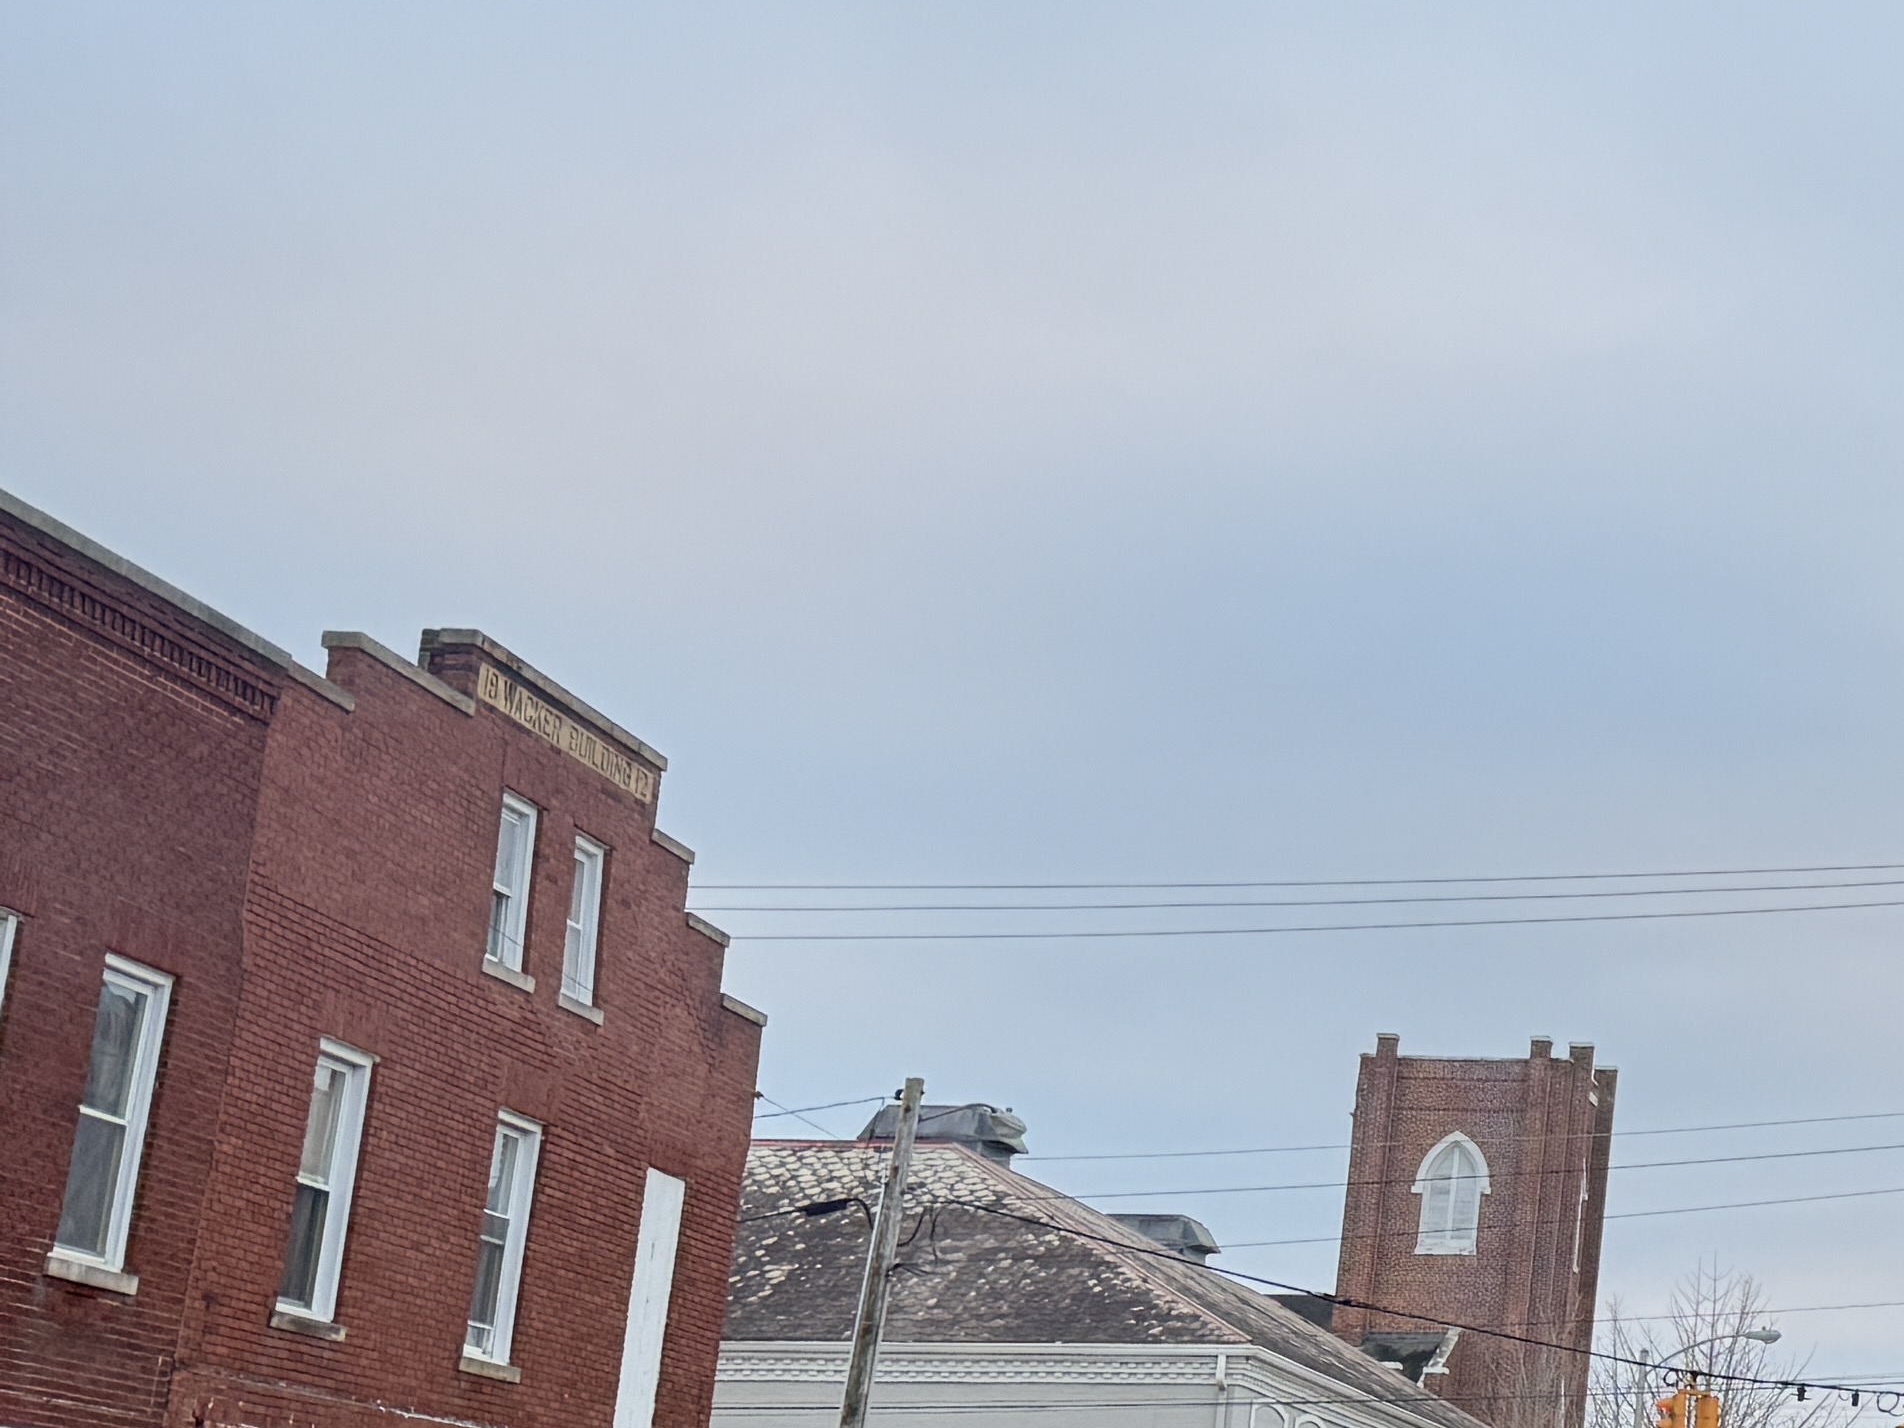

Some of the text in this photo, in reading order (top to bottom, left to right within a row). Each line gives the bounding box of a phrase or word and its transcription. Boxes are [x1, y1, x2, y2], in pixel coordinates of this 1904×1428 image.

[483, 667, 498, 700] 19
[503, 679, 563, 744] WACKER
[569, 723, 633, 786] BUILDING
